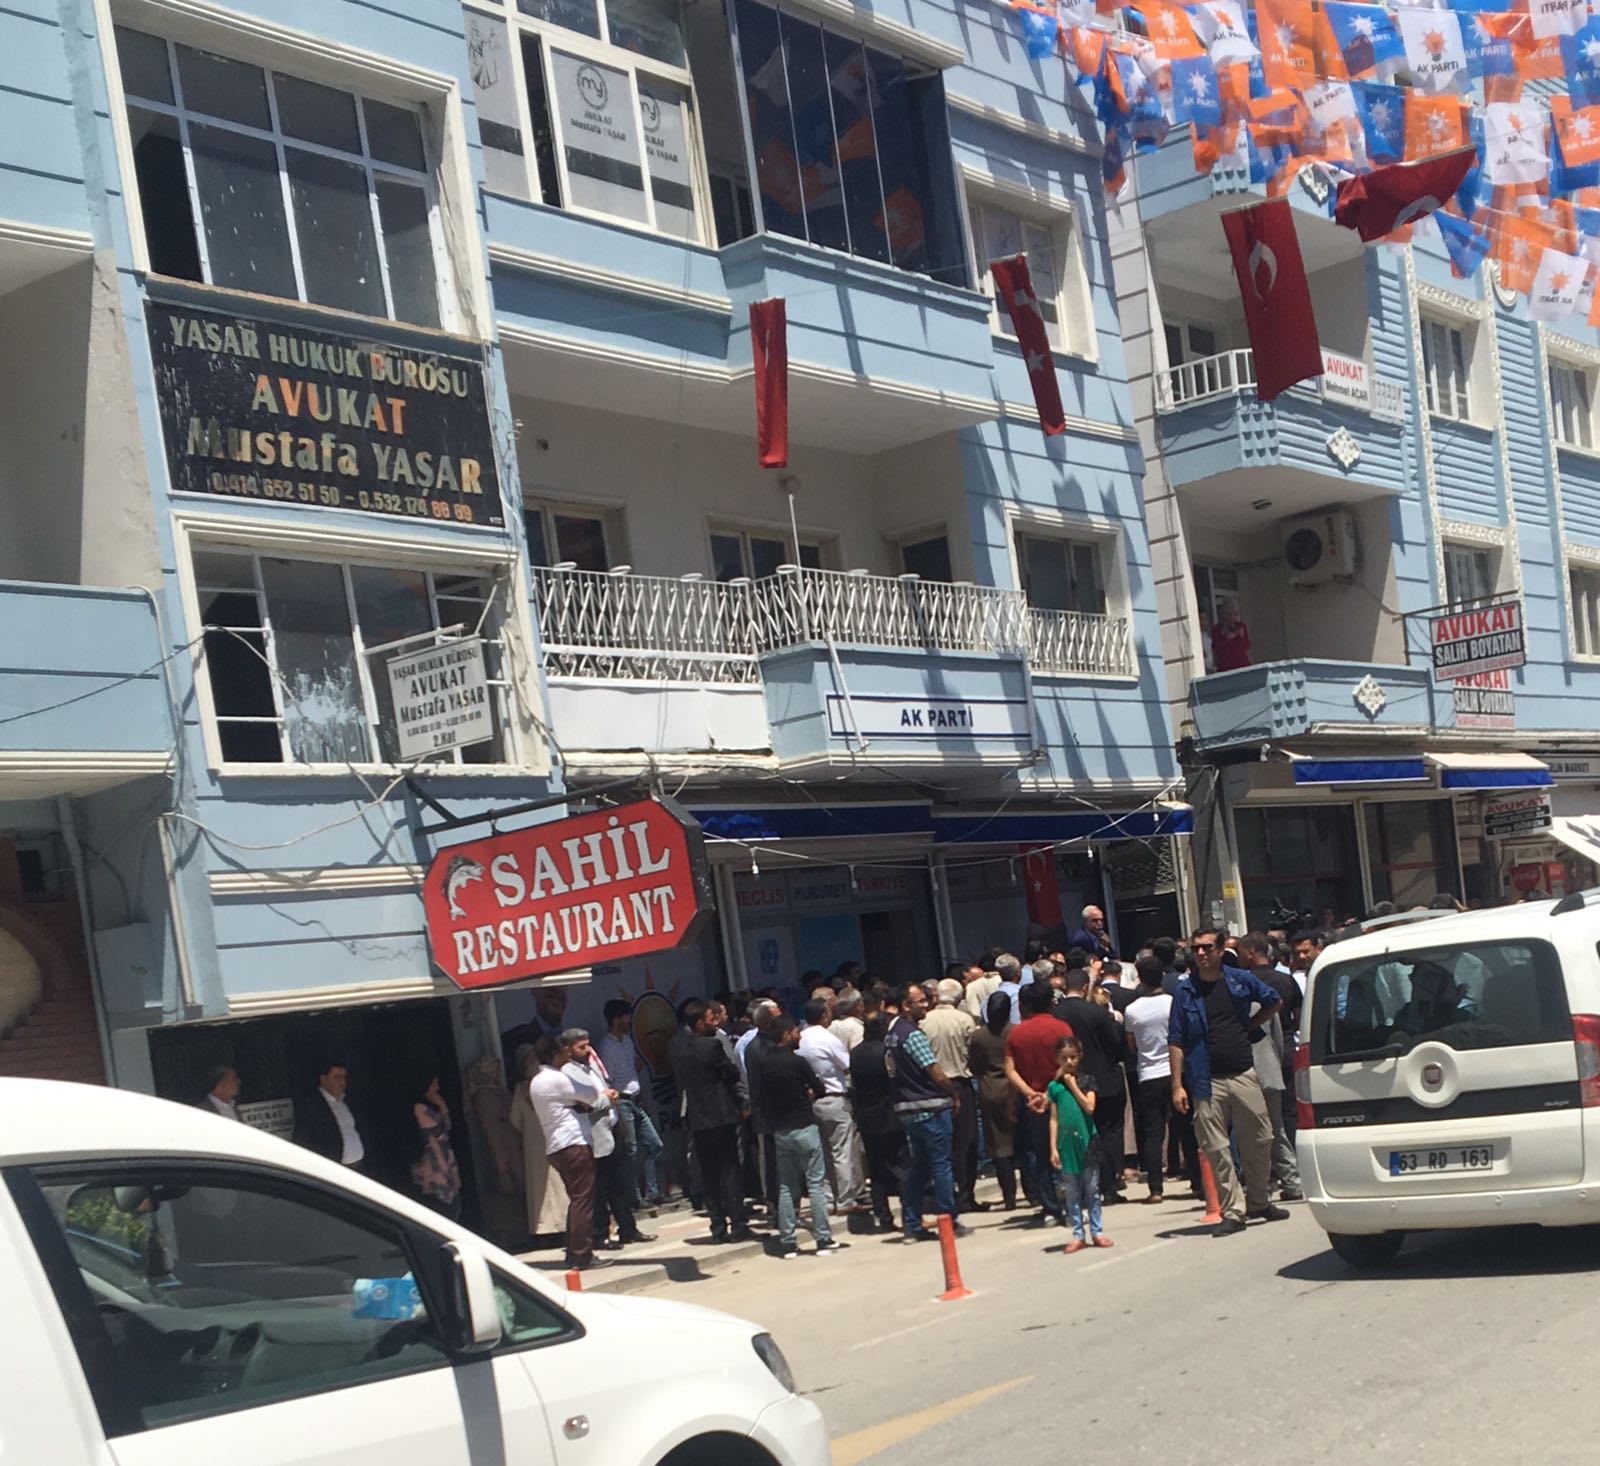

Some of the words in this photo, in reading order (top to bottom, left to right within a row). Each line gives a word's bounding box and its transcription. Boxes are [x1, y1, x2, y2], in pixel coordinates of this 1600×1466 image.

[1416, 65, 1430, 73] AK
[169, 315, 261, 360] YAŞAR
[268, 333, 364, 378] HUKUK
[1327, 357, 1363, 382] AVUKAT
[252, 374, 408, 435] AVUKAT
[187, 416, 360, 478] Mustafa
[372, 442, 484, 497] YAŞAR
[264, 478, 295, 500] 652
[299, 483, 316, 503] 51
[1436, 605, 1516, 643] AVUKAT
[1471, 631, 1522, 660] BOYATAN
[410, 665, 467, 699] AVUKAT
[400, 696, 446, 724] Mustafa
[900, 708, 924, 727] AK
[928, 705, 974, 727] PARTİ
[1487, 796, 1547, 815] AVUKAT
[490, 815, 671, 908] SAHİL
[452, 884, 675, 975] RESTAURANT
[1399, 1154, 1417, 1172] 63
[1428, 1152, 1448, 1169] RD
[1461, 1148, 1490, 1167] 163
